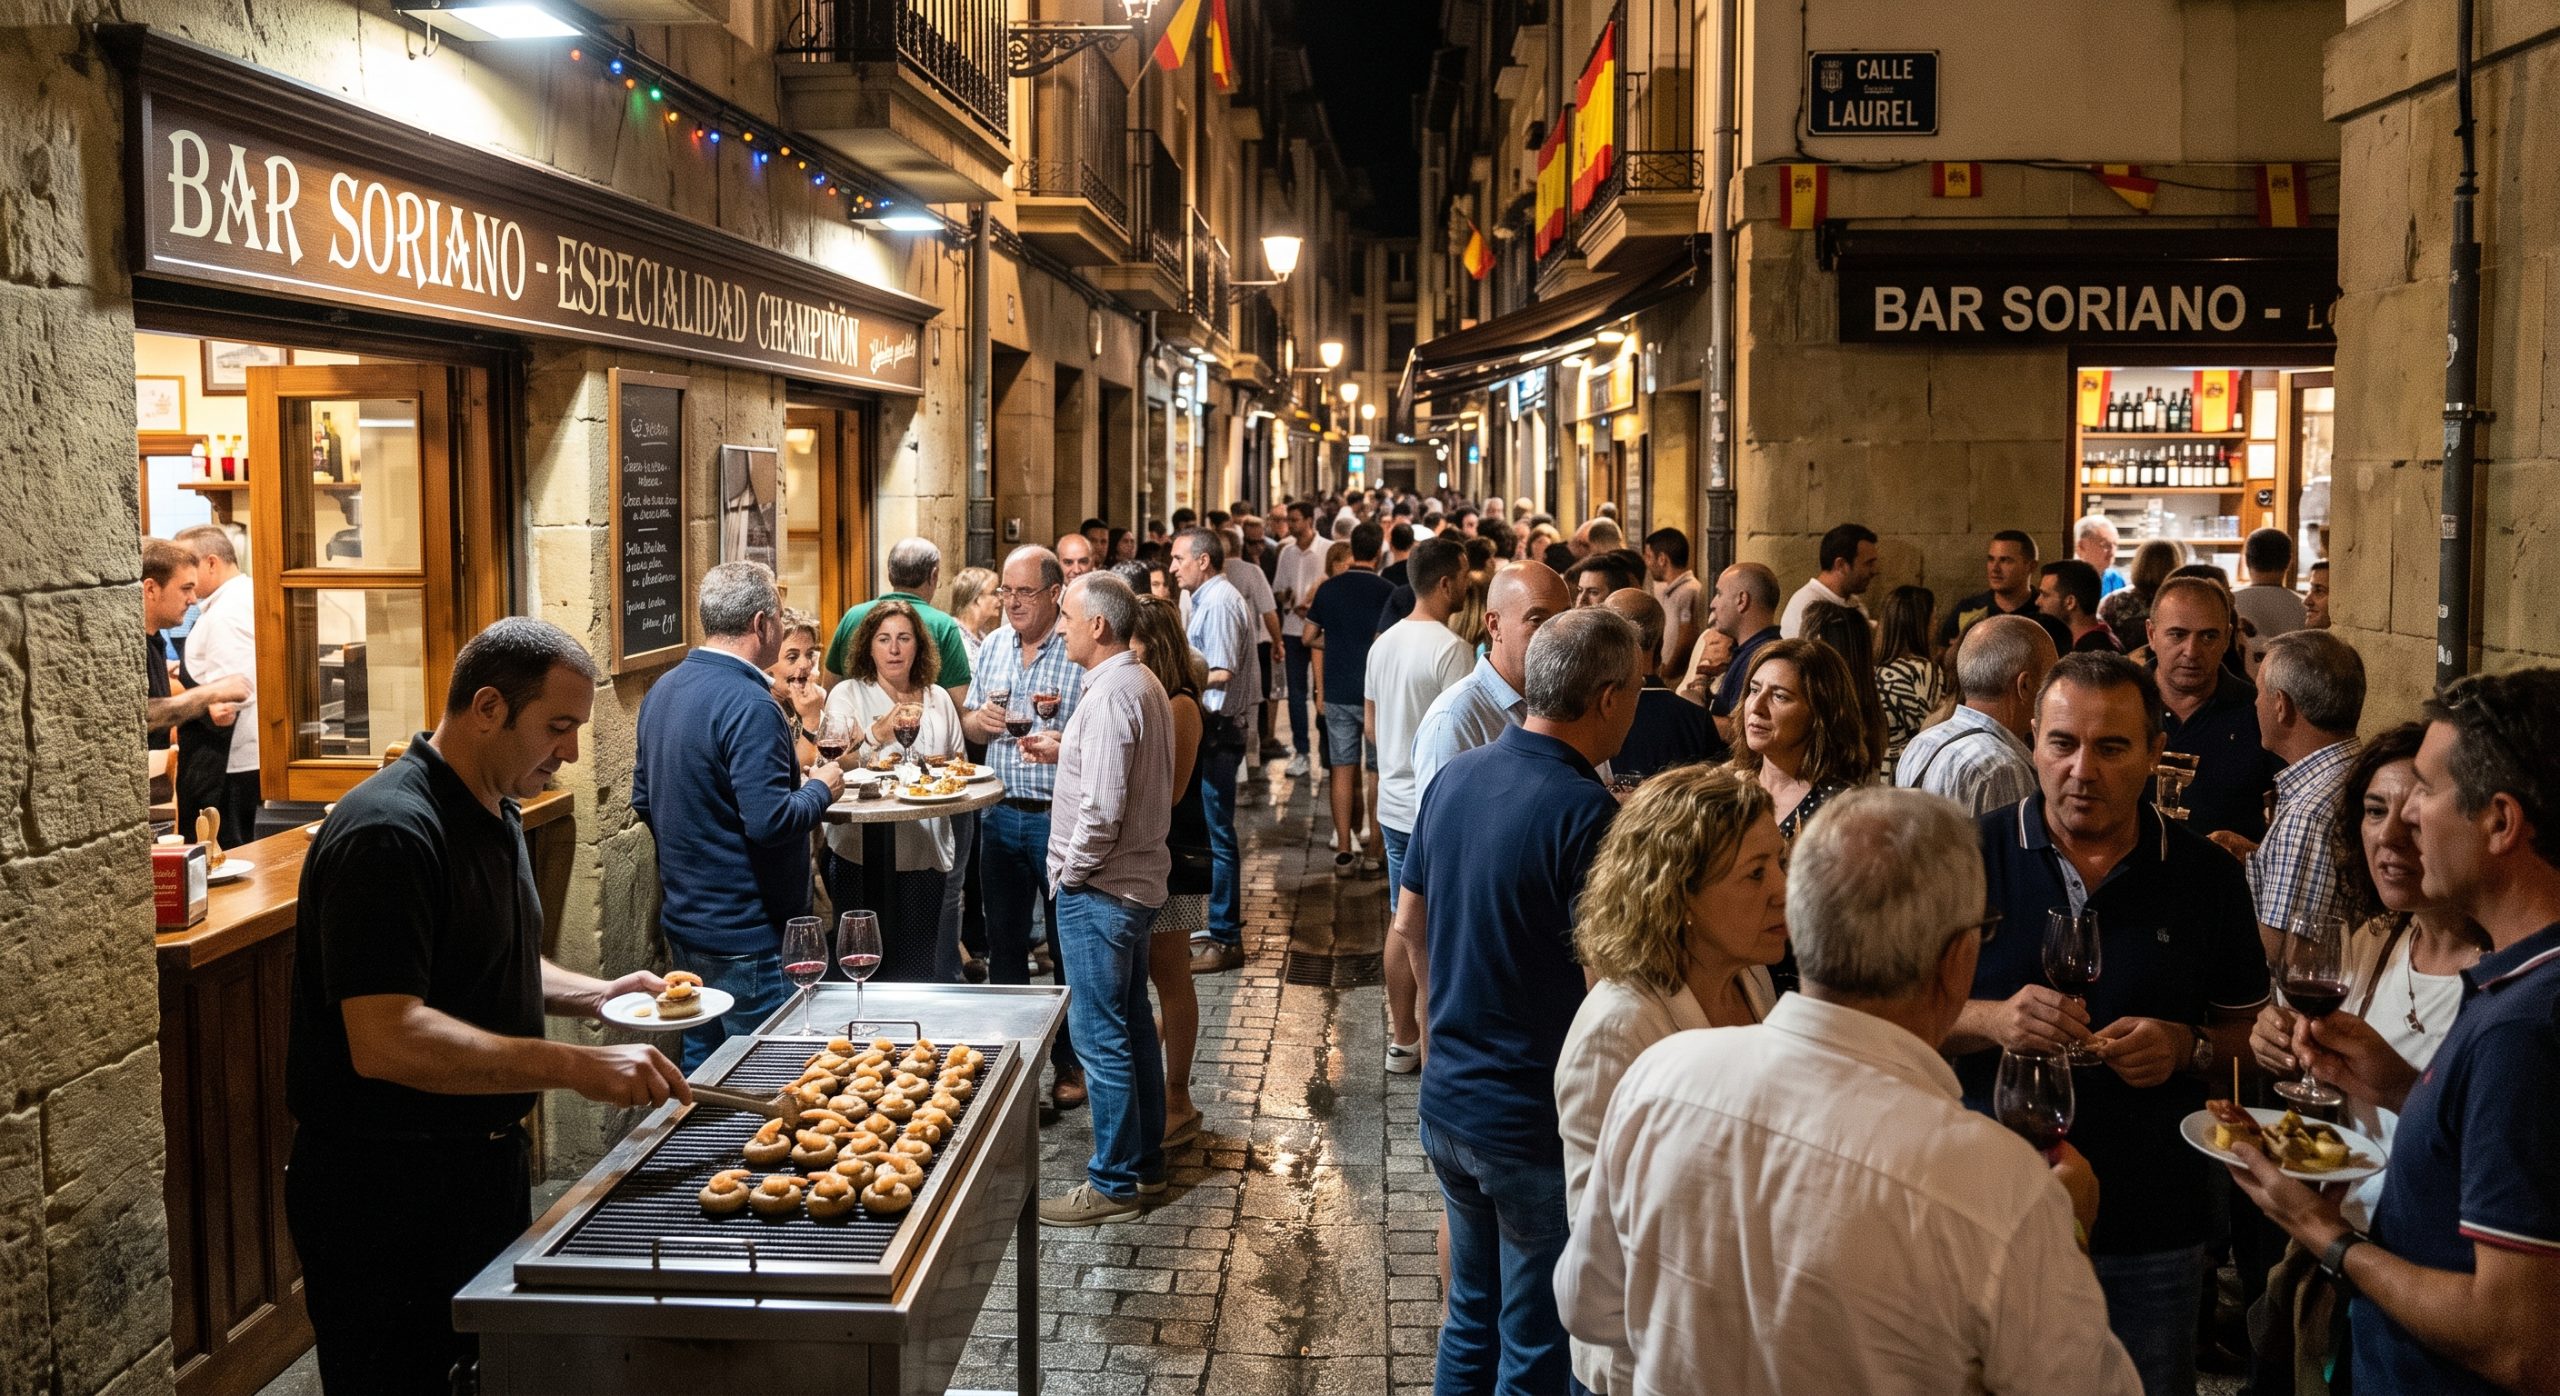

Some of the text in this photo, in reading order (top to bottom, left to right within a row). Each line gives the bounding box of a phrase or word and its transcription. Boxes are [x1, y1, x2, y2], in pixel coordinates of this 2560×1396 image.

[1856, 59, 1914, 80] CALLE
[1828, 100, 1919, 127] LAUREL
[168, 129, 304, 266] BAR
[328, 172, 526, 301] SORIANO
[556, 235, 748, 344] ESPECIALIDAD
[1874, 285, 1986, 332] BAR
[2001, 284, 2247, 333] SORIANO
